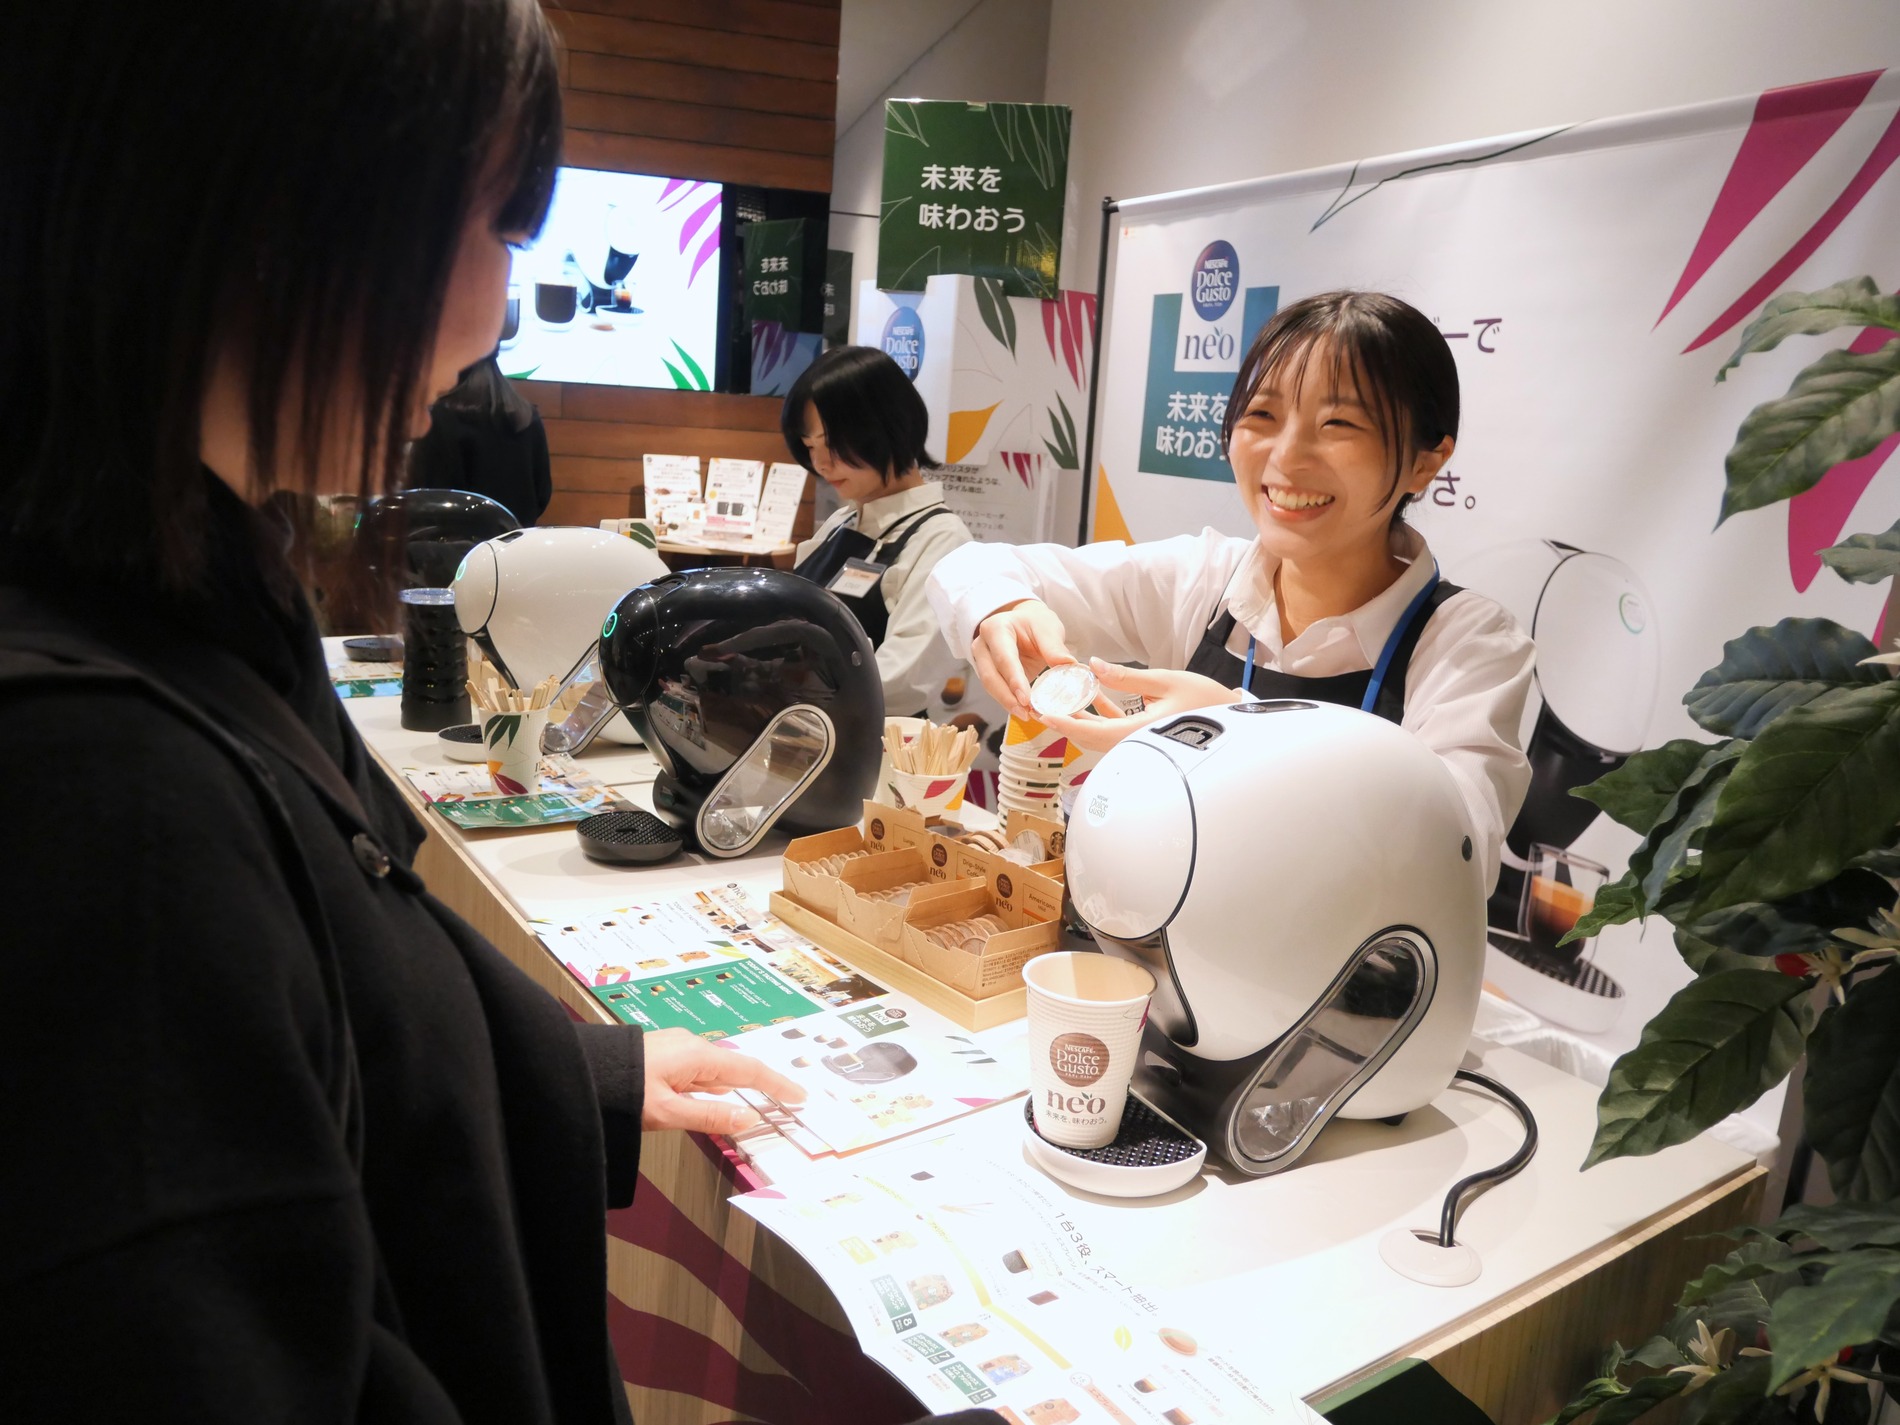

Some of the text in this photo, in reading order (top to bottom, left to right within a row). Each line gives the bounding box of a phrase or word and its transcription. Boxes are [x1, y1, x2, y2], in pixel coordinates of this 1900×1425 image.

[921, 163, 1003, 193] 未来を
[919, 203, 1026, 233] 味わおう
[1197, 269, 1232, 288] Dolce
[1196, 286, 1231, 303] Gusto
[1432, 316, 1503, 354] ーで
[886, 336, 919, 355] Dolce
[894, 355, 918, 369] usto
[1167, 391, 1230, 423] 未来を
[962, 858, 986, 874] Drip-Style
[1028, 893, 1056, 911] Americano
[1056, 1048, 1100, 1066] Dolce
[1056, 1059, 1099, 1075] Gusto
[1045, 1109, 1108, 1126] 未来を、味わおう。
[902, 1317, 913, 1327] 8
